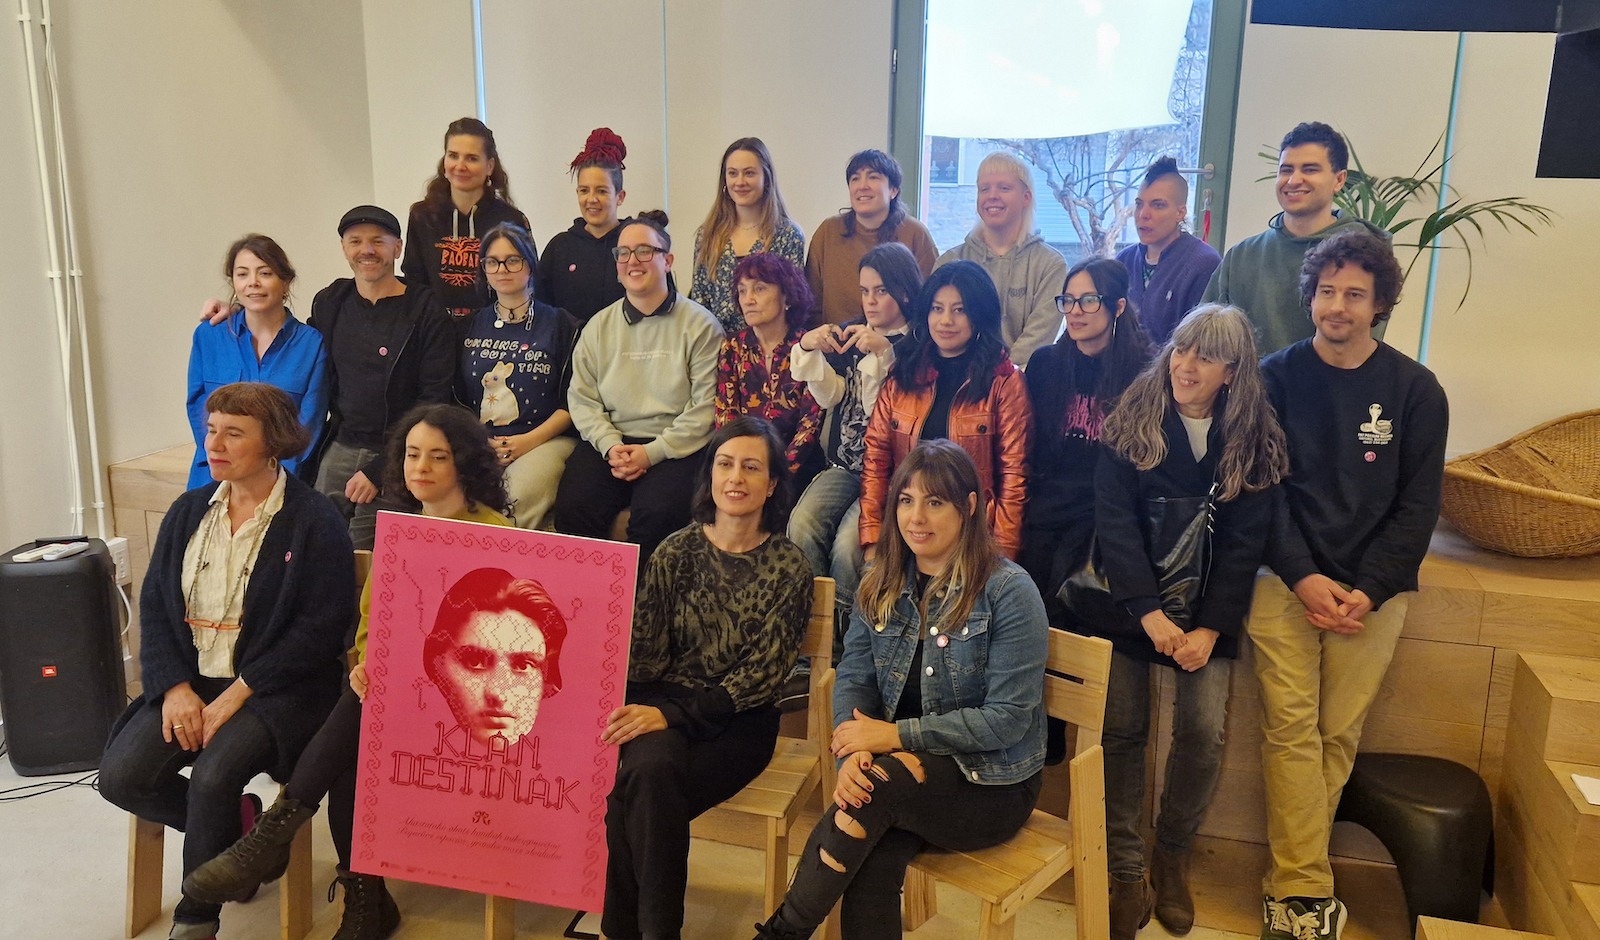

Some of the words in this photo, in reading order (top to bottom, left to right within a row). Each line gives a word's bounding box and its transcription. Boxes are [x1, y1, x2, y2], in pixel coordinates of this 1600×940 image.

[480, 349, 507, 360] OUT
[524, 350, 543, 361] OF
[518, 363, 552, 374] TIME
[433, 721, 541, 770] KLAN
[389, 751, 580, 813] DESTINAK
